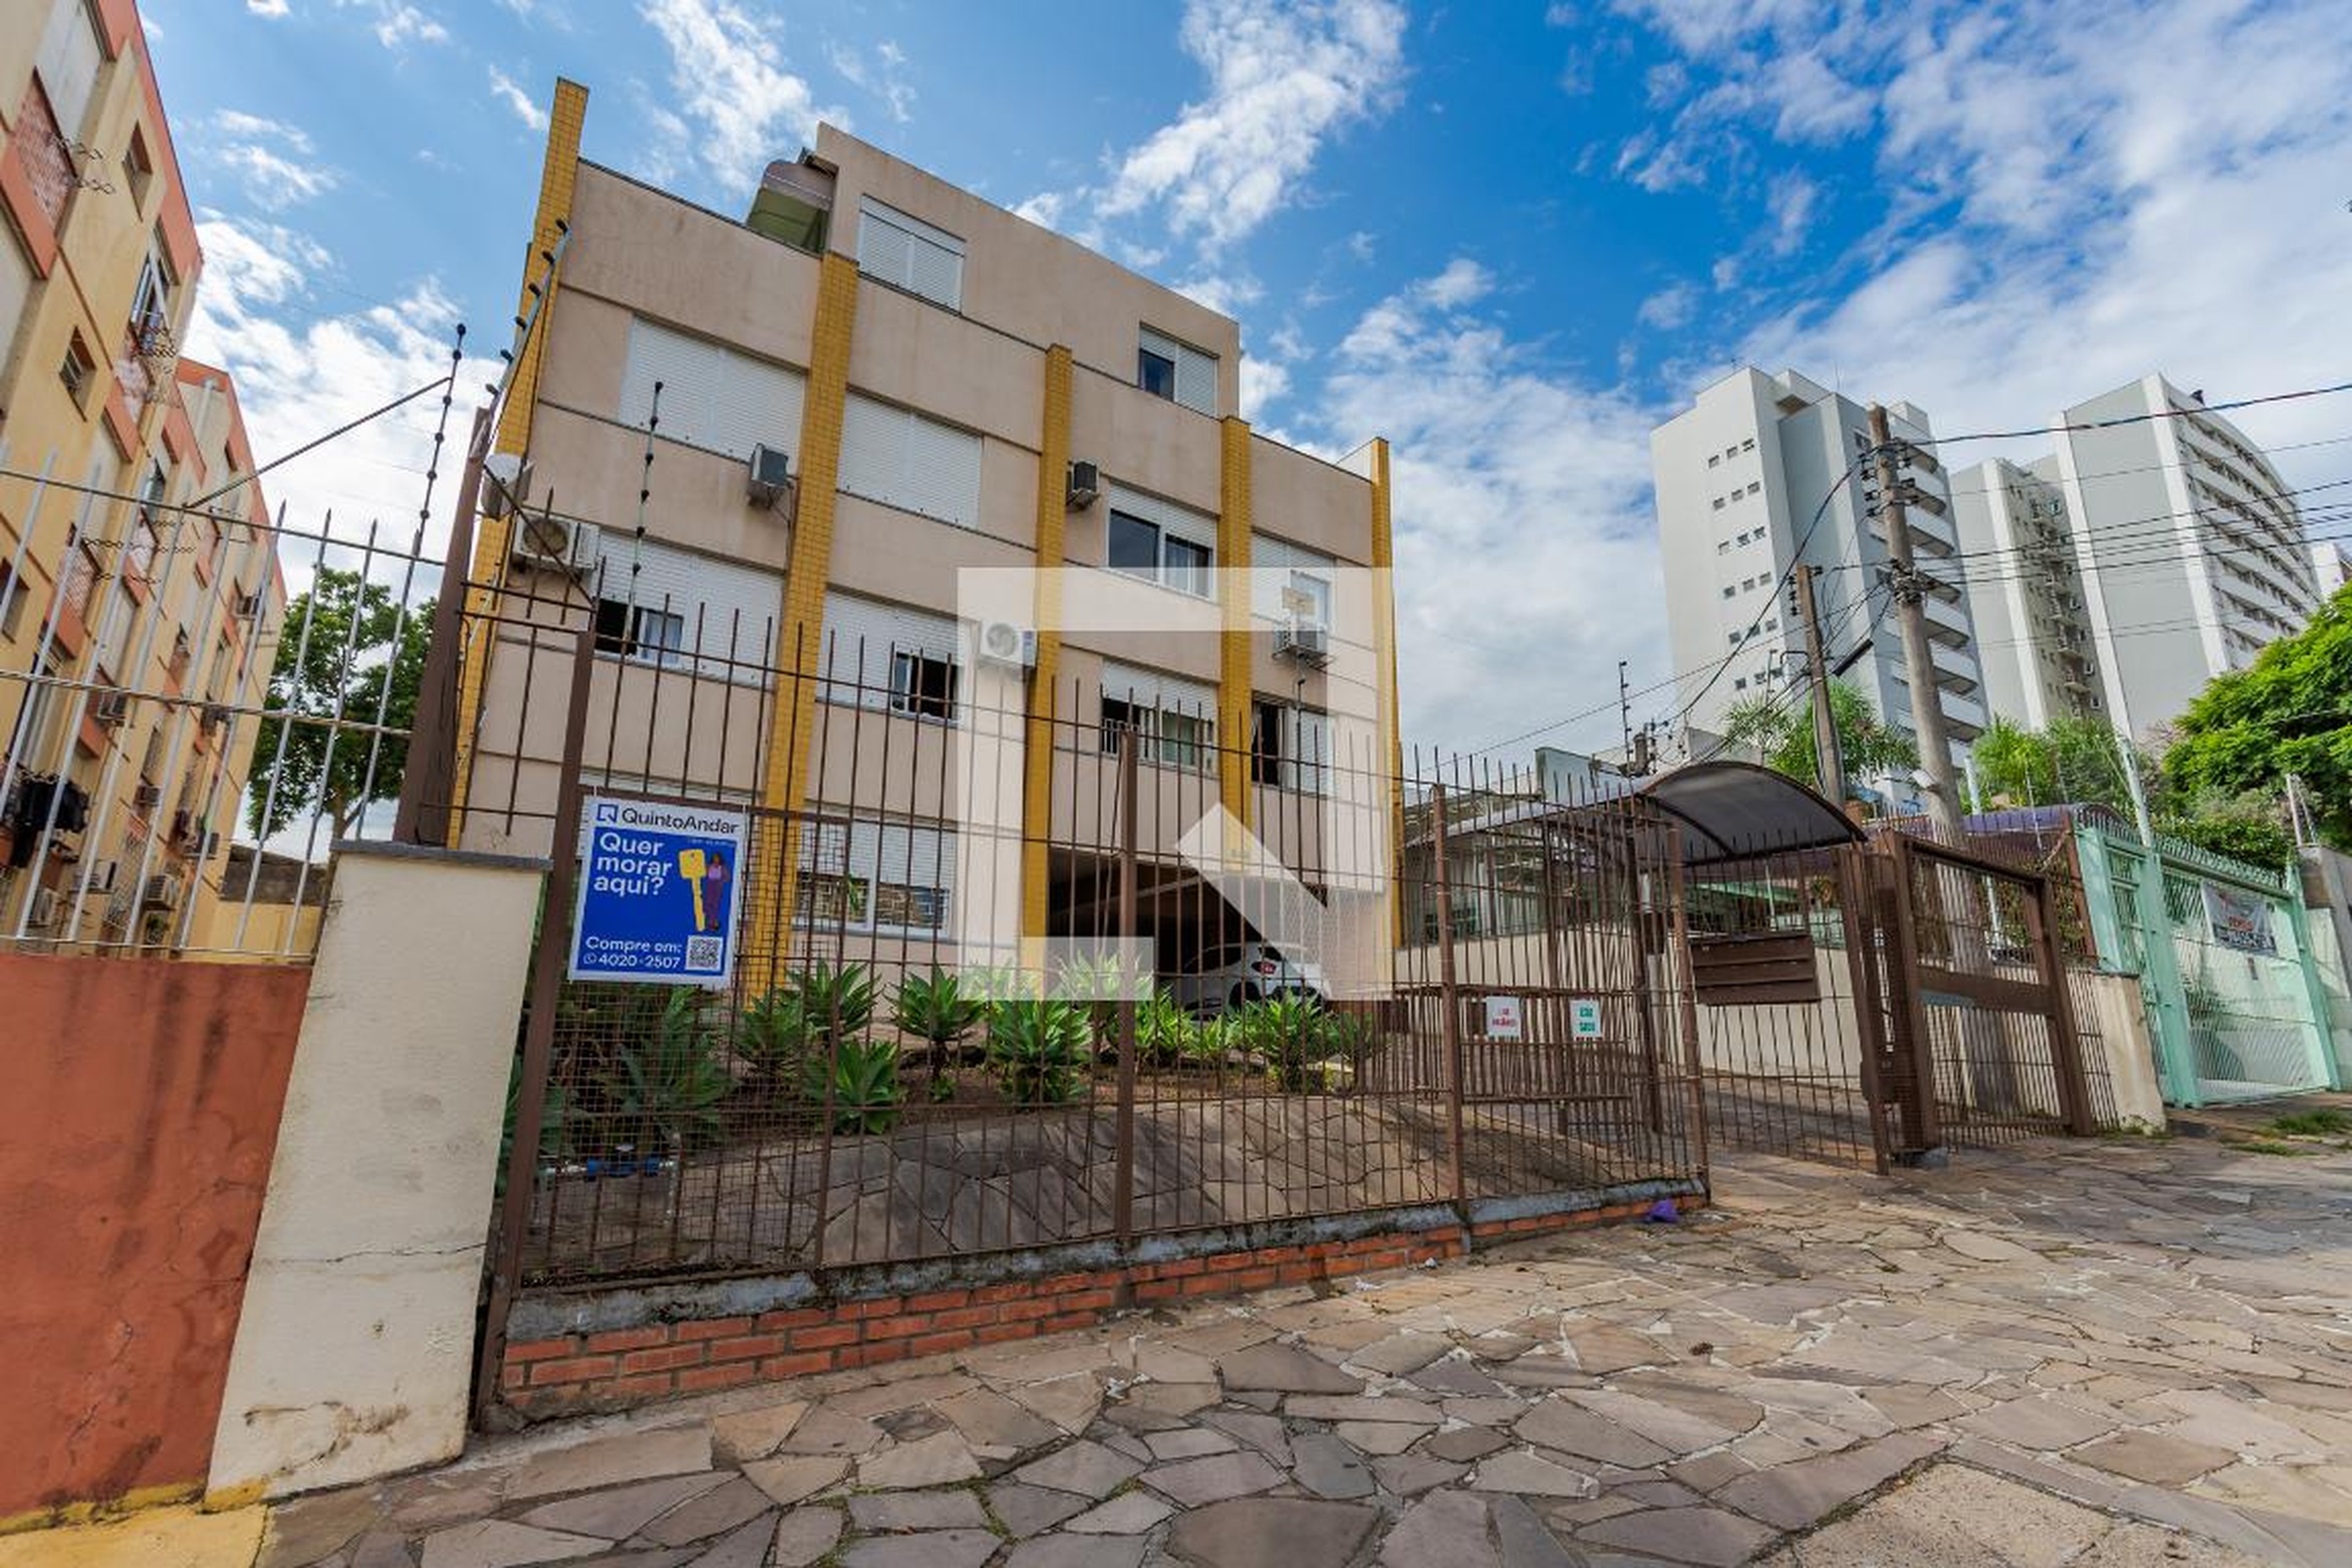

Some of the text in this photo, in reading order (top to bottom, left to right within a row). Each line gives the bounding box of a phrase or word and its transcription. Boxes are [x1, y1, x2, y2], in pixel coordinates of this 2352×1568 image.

[622, 807, 738, 834] QuintoAndar
[600, 832, 663, 856] Quer
[596, 855, 673, 877] morar
[593, 875, 665, 897] aqui?
[586, 936, 682, 954] Compre em:
